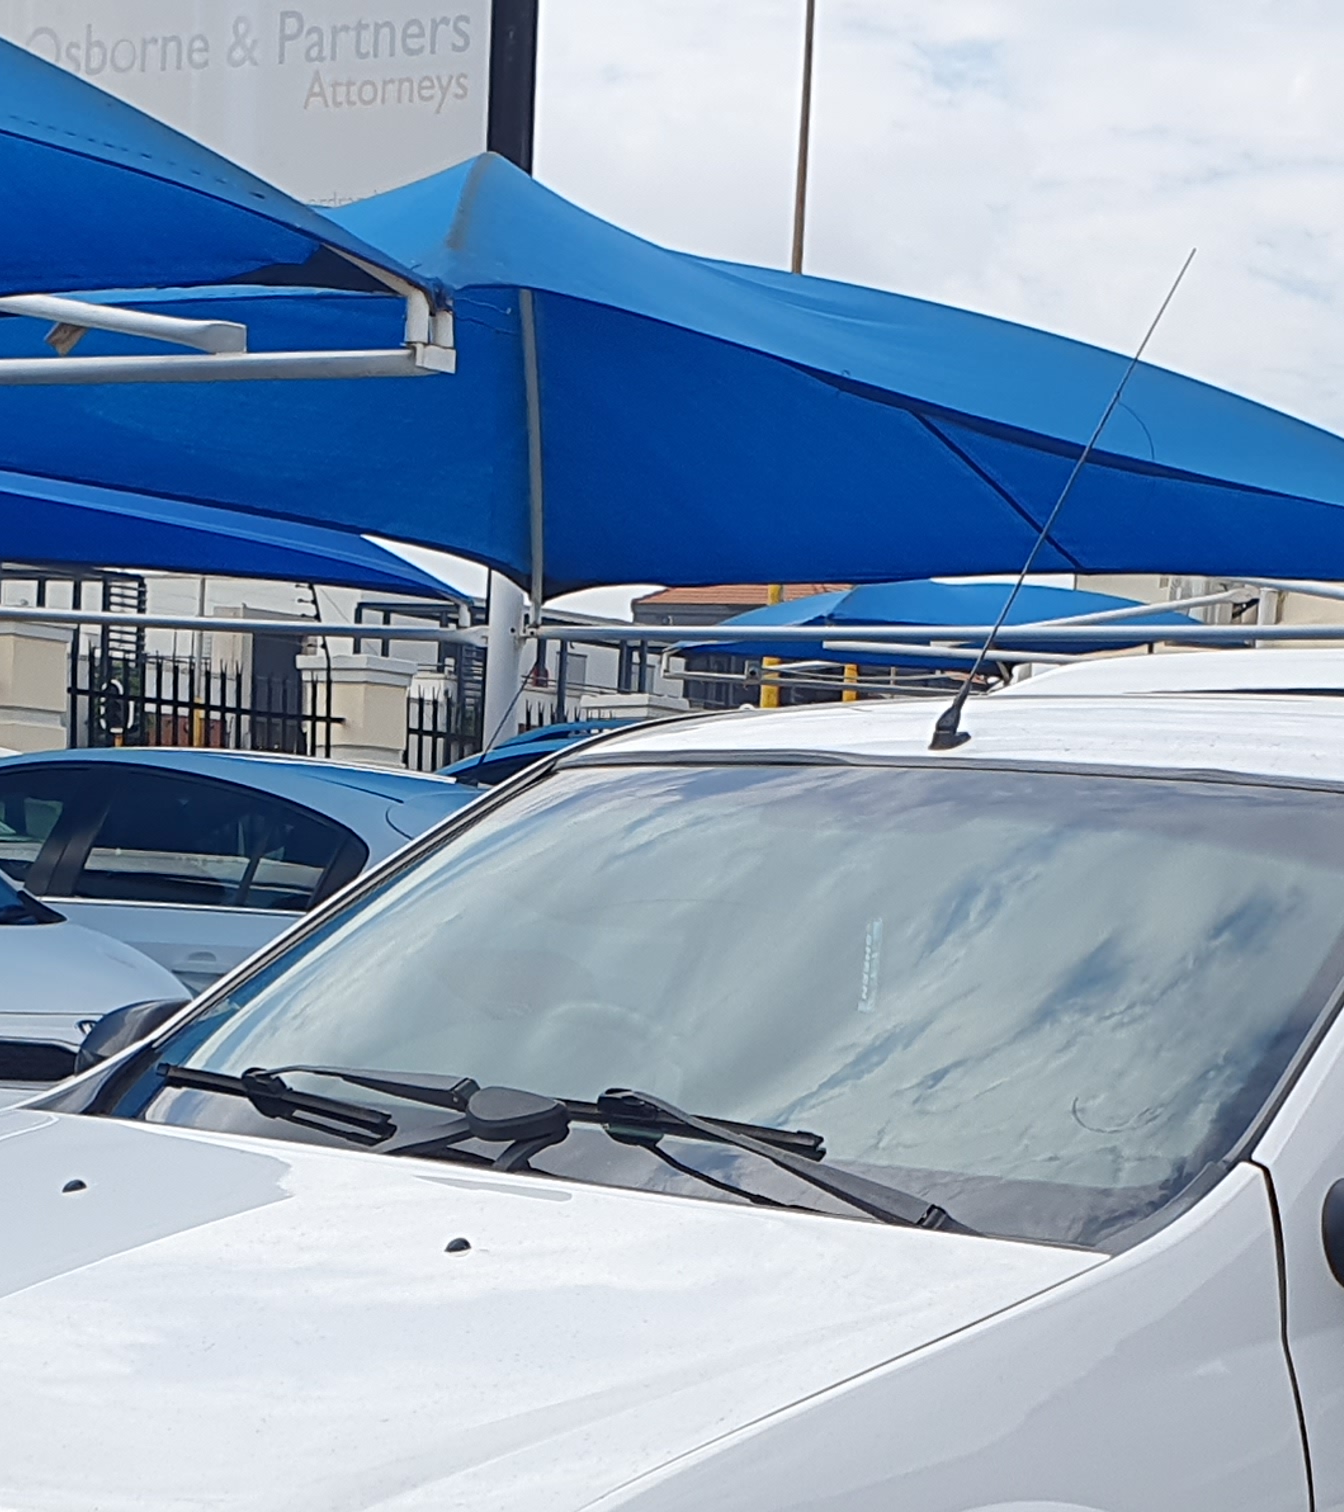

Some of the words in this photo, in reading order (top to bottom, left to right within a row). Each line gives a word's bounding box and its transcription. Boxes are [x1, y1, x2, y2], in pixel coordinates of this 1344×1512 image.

[27, 23, 210, 77] Osborne
[225, 14, 260, 69] &
[277, 9, 472, 65] Partners
[303, 69, 470, 114] Attorneys
